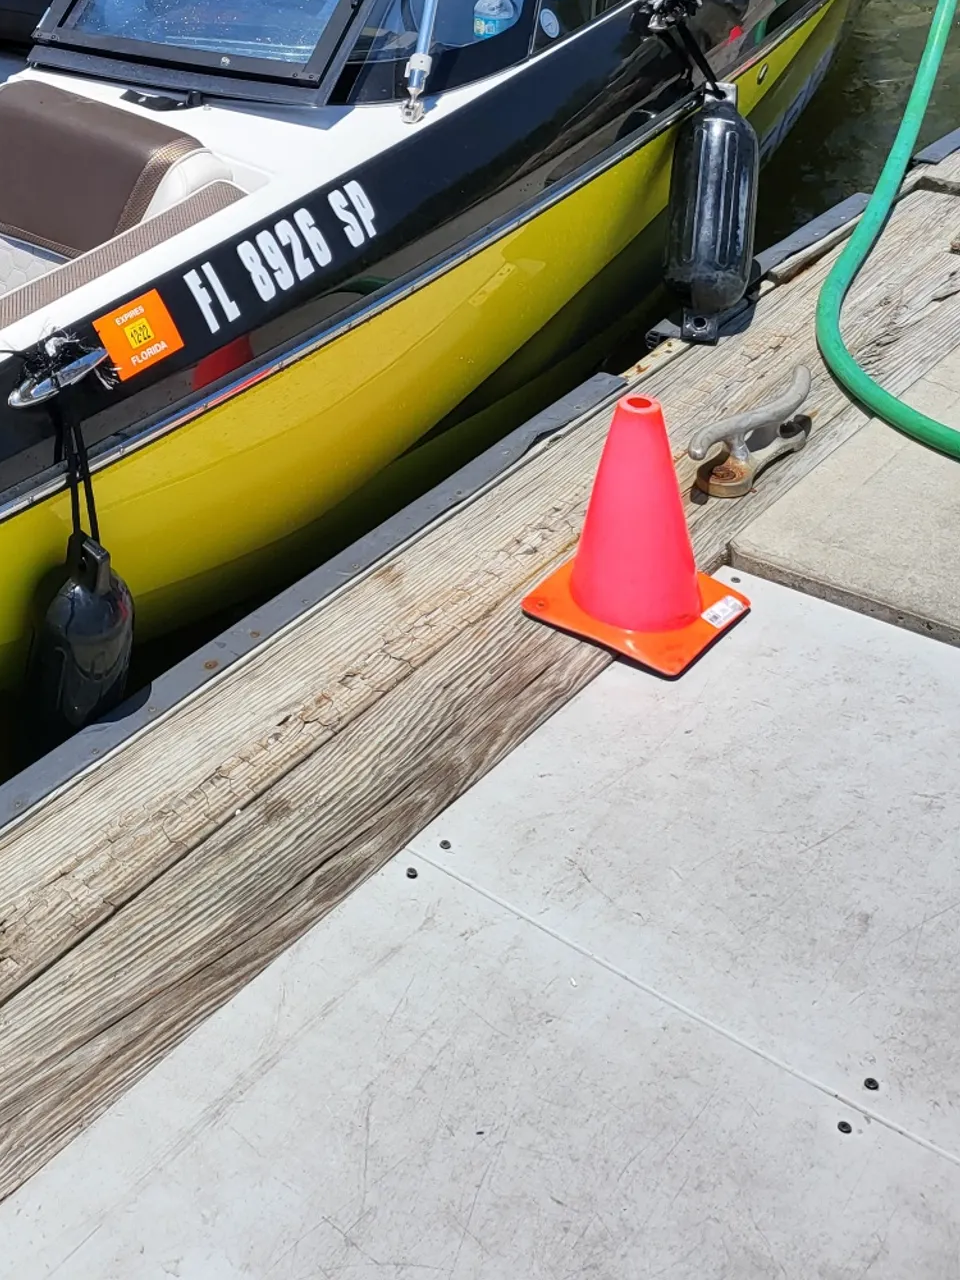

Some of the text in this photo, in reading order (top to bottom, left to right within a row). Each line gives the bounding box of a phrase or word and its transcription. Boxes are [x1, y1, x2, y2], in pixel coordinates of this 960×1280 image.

[183, 180, 377, 334] FL 8926 SP
[115, 305, 145, 325] EXPIRES
[131, 341, 168, 366] FLORIDA
